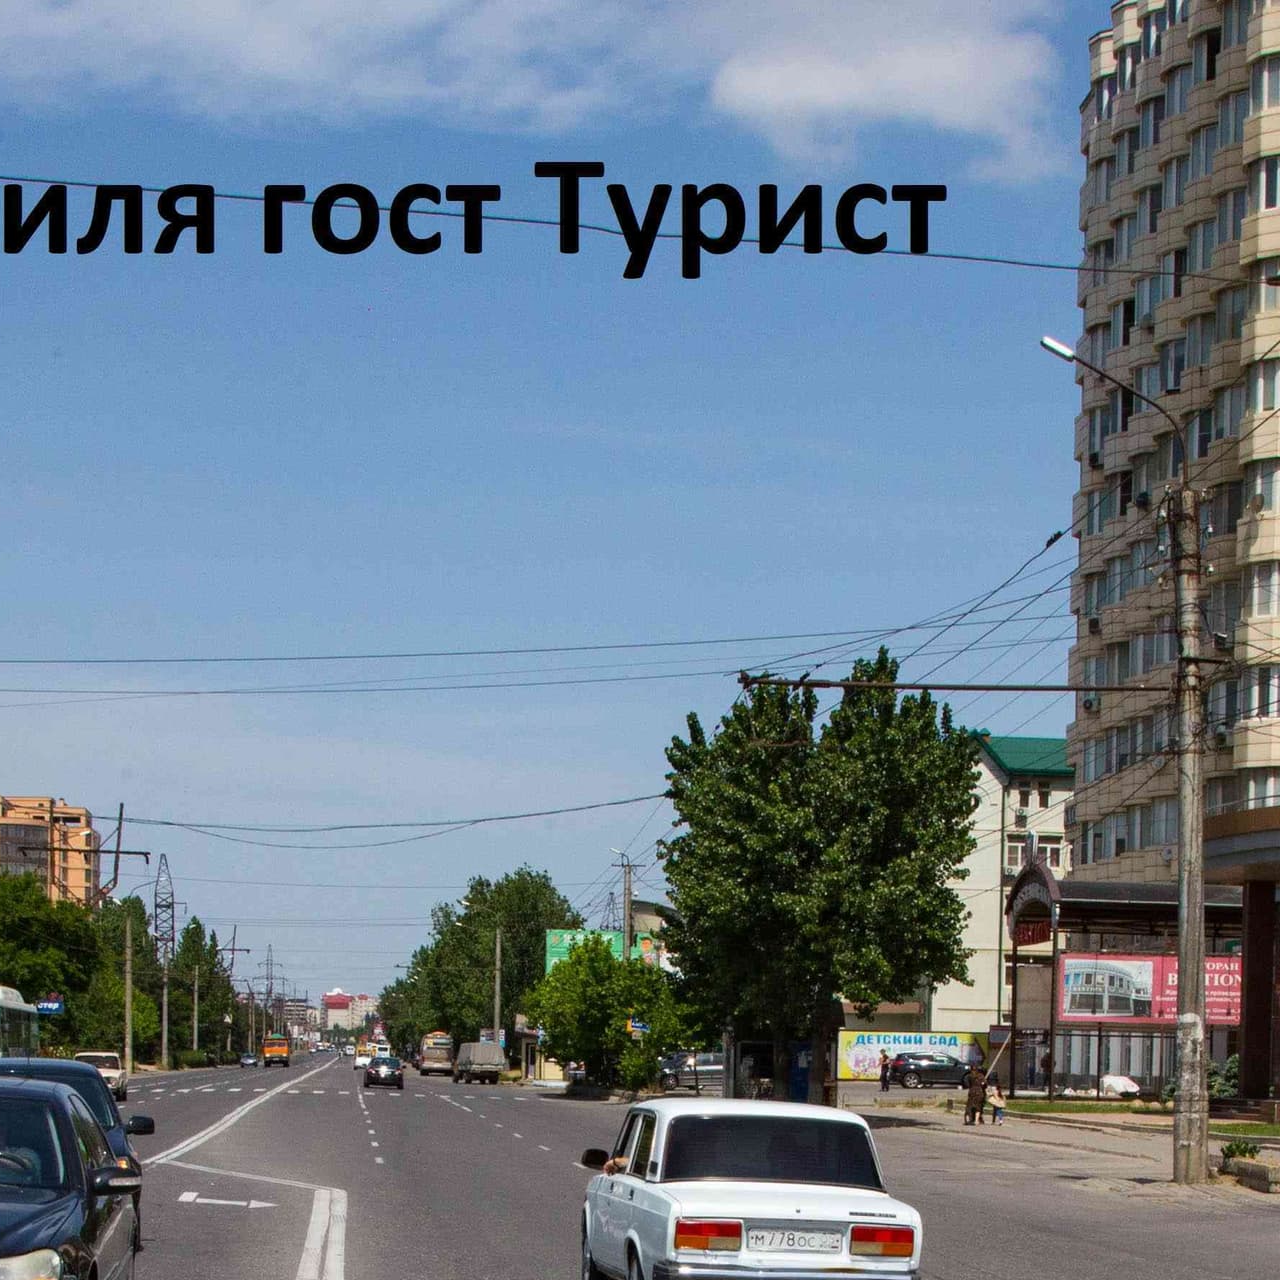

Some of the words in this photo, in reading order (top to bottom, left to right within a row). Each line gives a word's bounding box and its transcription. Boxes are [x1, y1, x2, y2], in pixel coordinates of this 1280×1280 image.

[1168, 973, 1242, 986] BTION
[855, 1033, 923, 1046] ДЕТСКИЙ
[929, 1034, 958, 1047] САД
